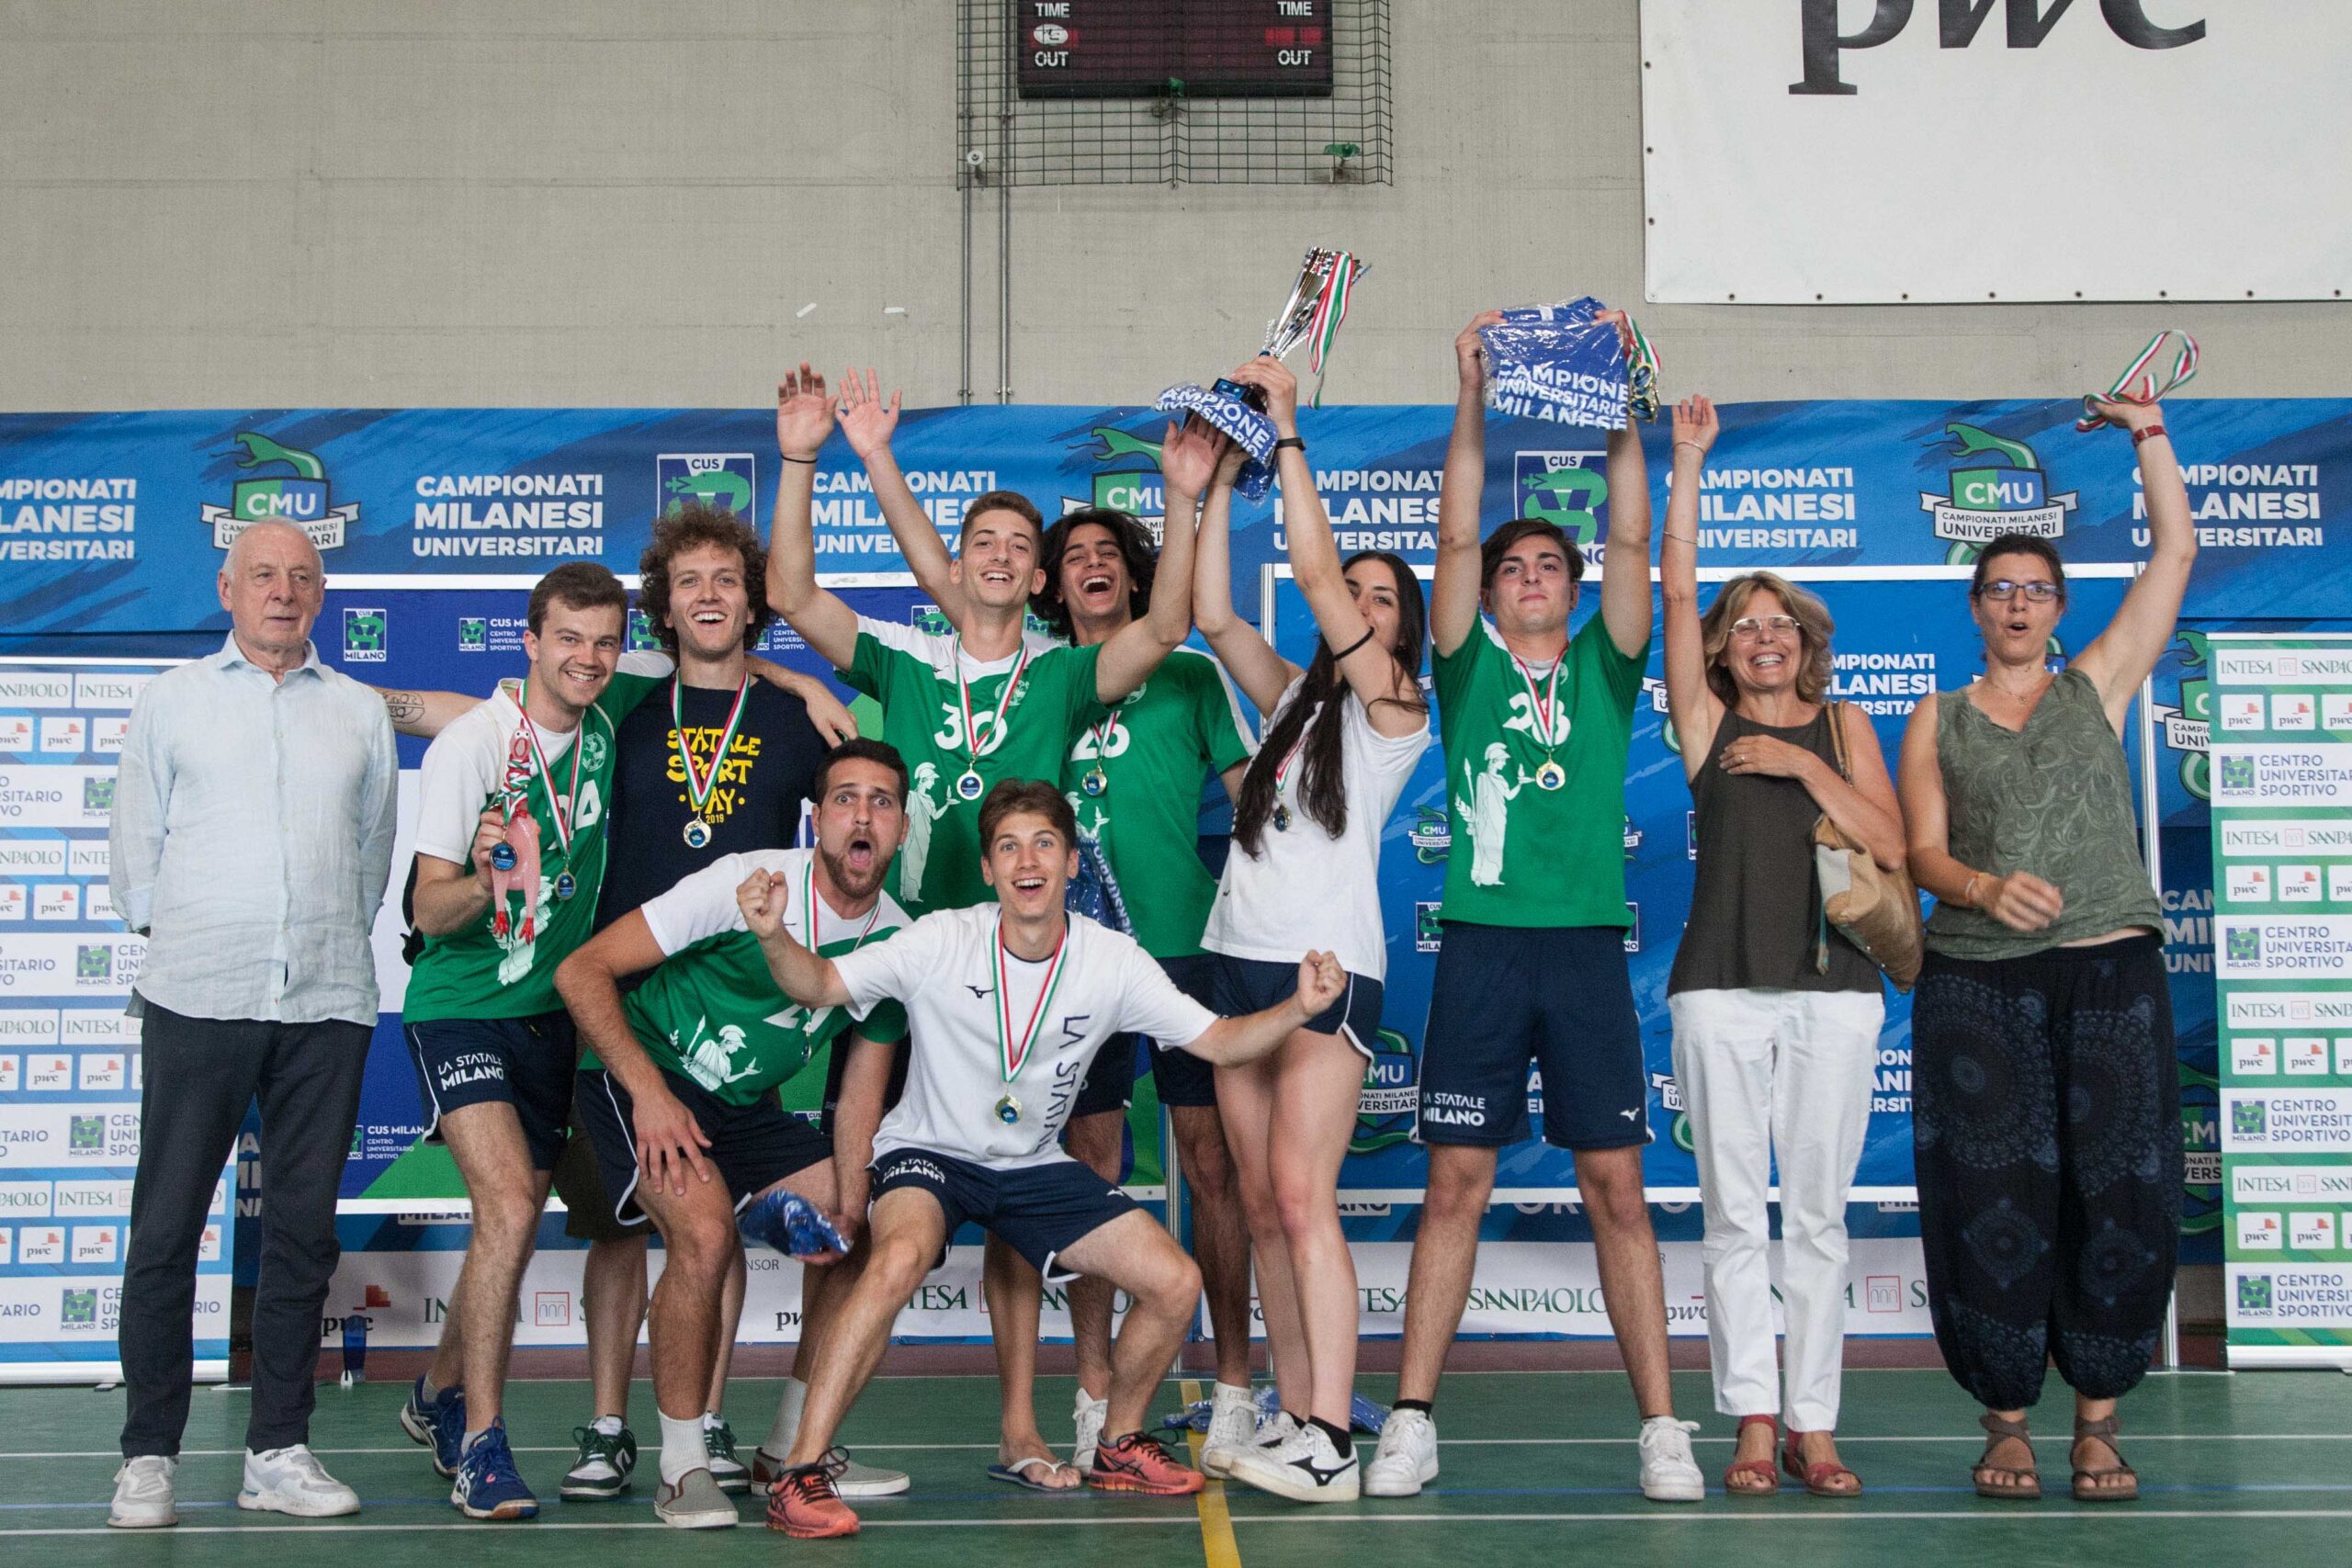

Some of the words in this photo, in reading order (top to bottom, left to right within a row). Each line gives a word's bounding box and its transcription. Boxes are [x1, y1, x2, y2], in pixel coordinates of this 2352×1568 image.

[1035, 2, 1070, 17] TIME
[1277, 2, 1313, 17] TIME
[1035, 51, 1069, 67] OUT
[1277, 51, 1312, 66] OUT
[691, 458, 719, 470] CUS
[1549, 456, 1577, 468] CUS
[813, 471, 996, 493] CAMONATI
[2132, 465, 2318, 486] CMPIONATI
[415, 474, 603, 497] CAMPIONATI
[1965, 481, 2034, 504] CMU
[246, 493, 316, 515] CMU
[1667, 493, 1856, 522] ILANESI
[414, 502, 603, 530] MILANESI
[1942, 512, 2006, 525] CAMPIONATI
[2008, 512, 2057, 525] MILANESI
[413, 536, 603, 557] UNIVERSITARI
[490, 618, 512, 627] CUS
[345, 651, 385, 660] MILANO
[2221, 660, 2273, 674] INTESA
[79, 684, 133, 698] INTESA
[2228, 716, 2253, 727] pwc
[2278, 716, 2303, 727] pwc
[2329, 716, 2352, 727] pwc
[933, 702, 1008, 756] 30
[48, 736, 73, 748] pwc
[100, 737, 125, 748] pwc
[2259, 755, 2324, 767] CENTRO
[2259, 784, 2337, 796] SPORTIVO
[706, 814, 725, 824] 2019
[1422, 827, 1446, 835] CMU
[2226, 830, 2279, 845] INTESA
[2233, 885, 2257, 896] pwc
[2285, 885, 2310, 896] pwc
[41, 904, 66, 914] pwc
[2266, 926, 2330, 939] CENTRO
[2266, 956, 2344, 968] SPORTIVO
[2232, 1003, 2285, 1018] INTESA
[66, 1020, 120, 1034] INTESA
[1058, 1015, 1091, 1049] LA
[438, 1061, 453, 1076] LA
[2239, 1058, 2264, 1068] pwc
[2291, 1058, 2315, 1068] pwc
[34, 1074, 59, 1085] pwc
[86, 1074, 111, 1085] pwc
[441, 1066, 504, 1091] MILANO
[1363, 1065, 1405, 1083] MU
[1434, 1092, 1486, 1110] STATALE
[2271, 1100, 2336, 1111] CENTRO
[1423, 1107, 1486, 1127] MILANO
[368, 1125, 389, 1134] CUS
[2271, 1130, 2350, 1142] SPORTIVO
[2237, 1178, 2291, 1191] INTESA
[59, 1191, 113, 1206] INTESA
[2245, 1233, 2269, 1244] pwc
[2297, 1233, 2323, 1244] pwc
[27, 1246, 51, 1258] pwc
[79, 1246, 104, 1257] pwc
[2278, 1274, 2343, 1286] CENTRO
